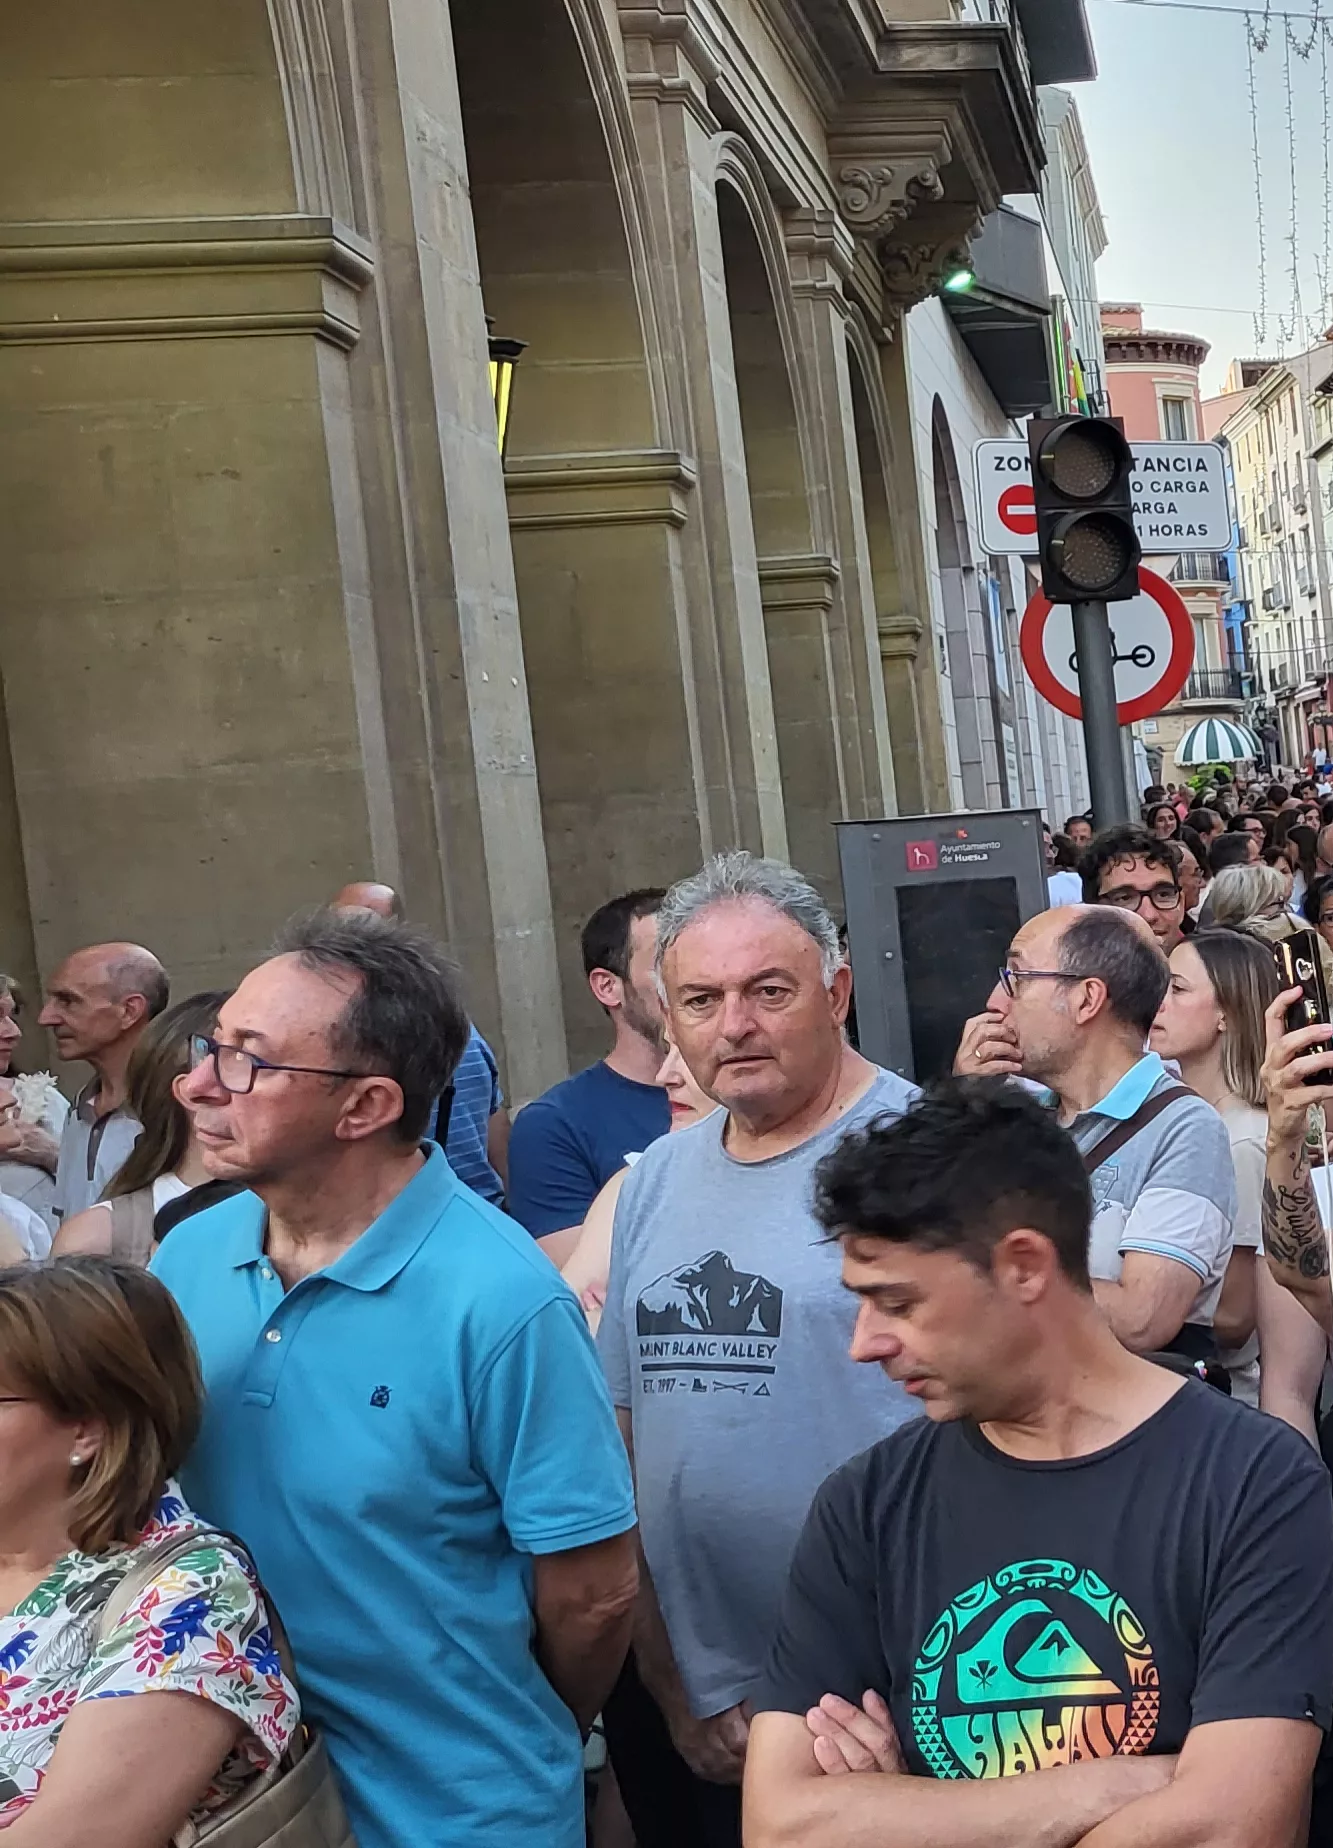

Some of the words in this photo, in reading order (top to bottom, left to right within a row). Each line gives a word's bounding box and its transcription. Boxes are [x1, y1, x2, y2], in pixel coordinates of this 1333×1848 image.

[994, 456, 1032, 472] ZON
[1131, 456, 1209, 473] TANCIA
[1132, 480, 1144, 494] O
[1149, 480, 1210, 494] CARGA
[1132, 501, 1178, 515] ARGA
[1149, 523, 1209, 537] HORAS
[940, 841, 1001, 855] Ayuntamiento
[942, 855, 953, 864] de
[954, 853, 989, 863] Huesca
[672, 1340, 717, 1357] BLANC
[722, 1342, 778, 1360] VALLEY
[657, 1377, 677, 1394] 1997
